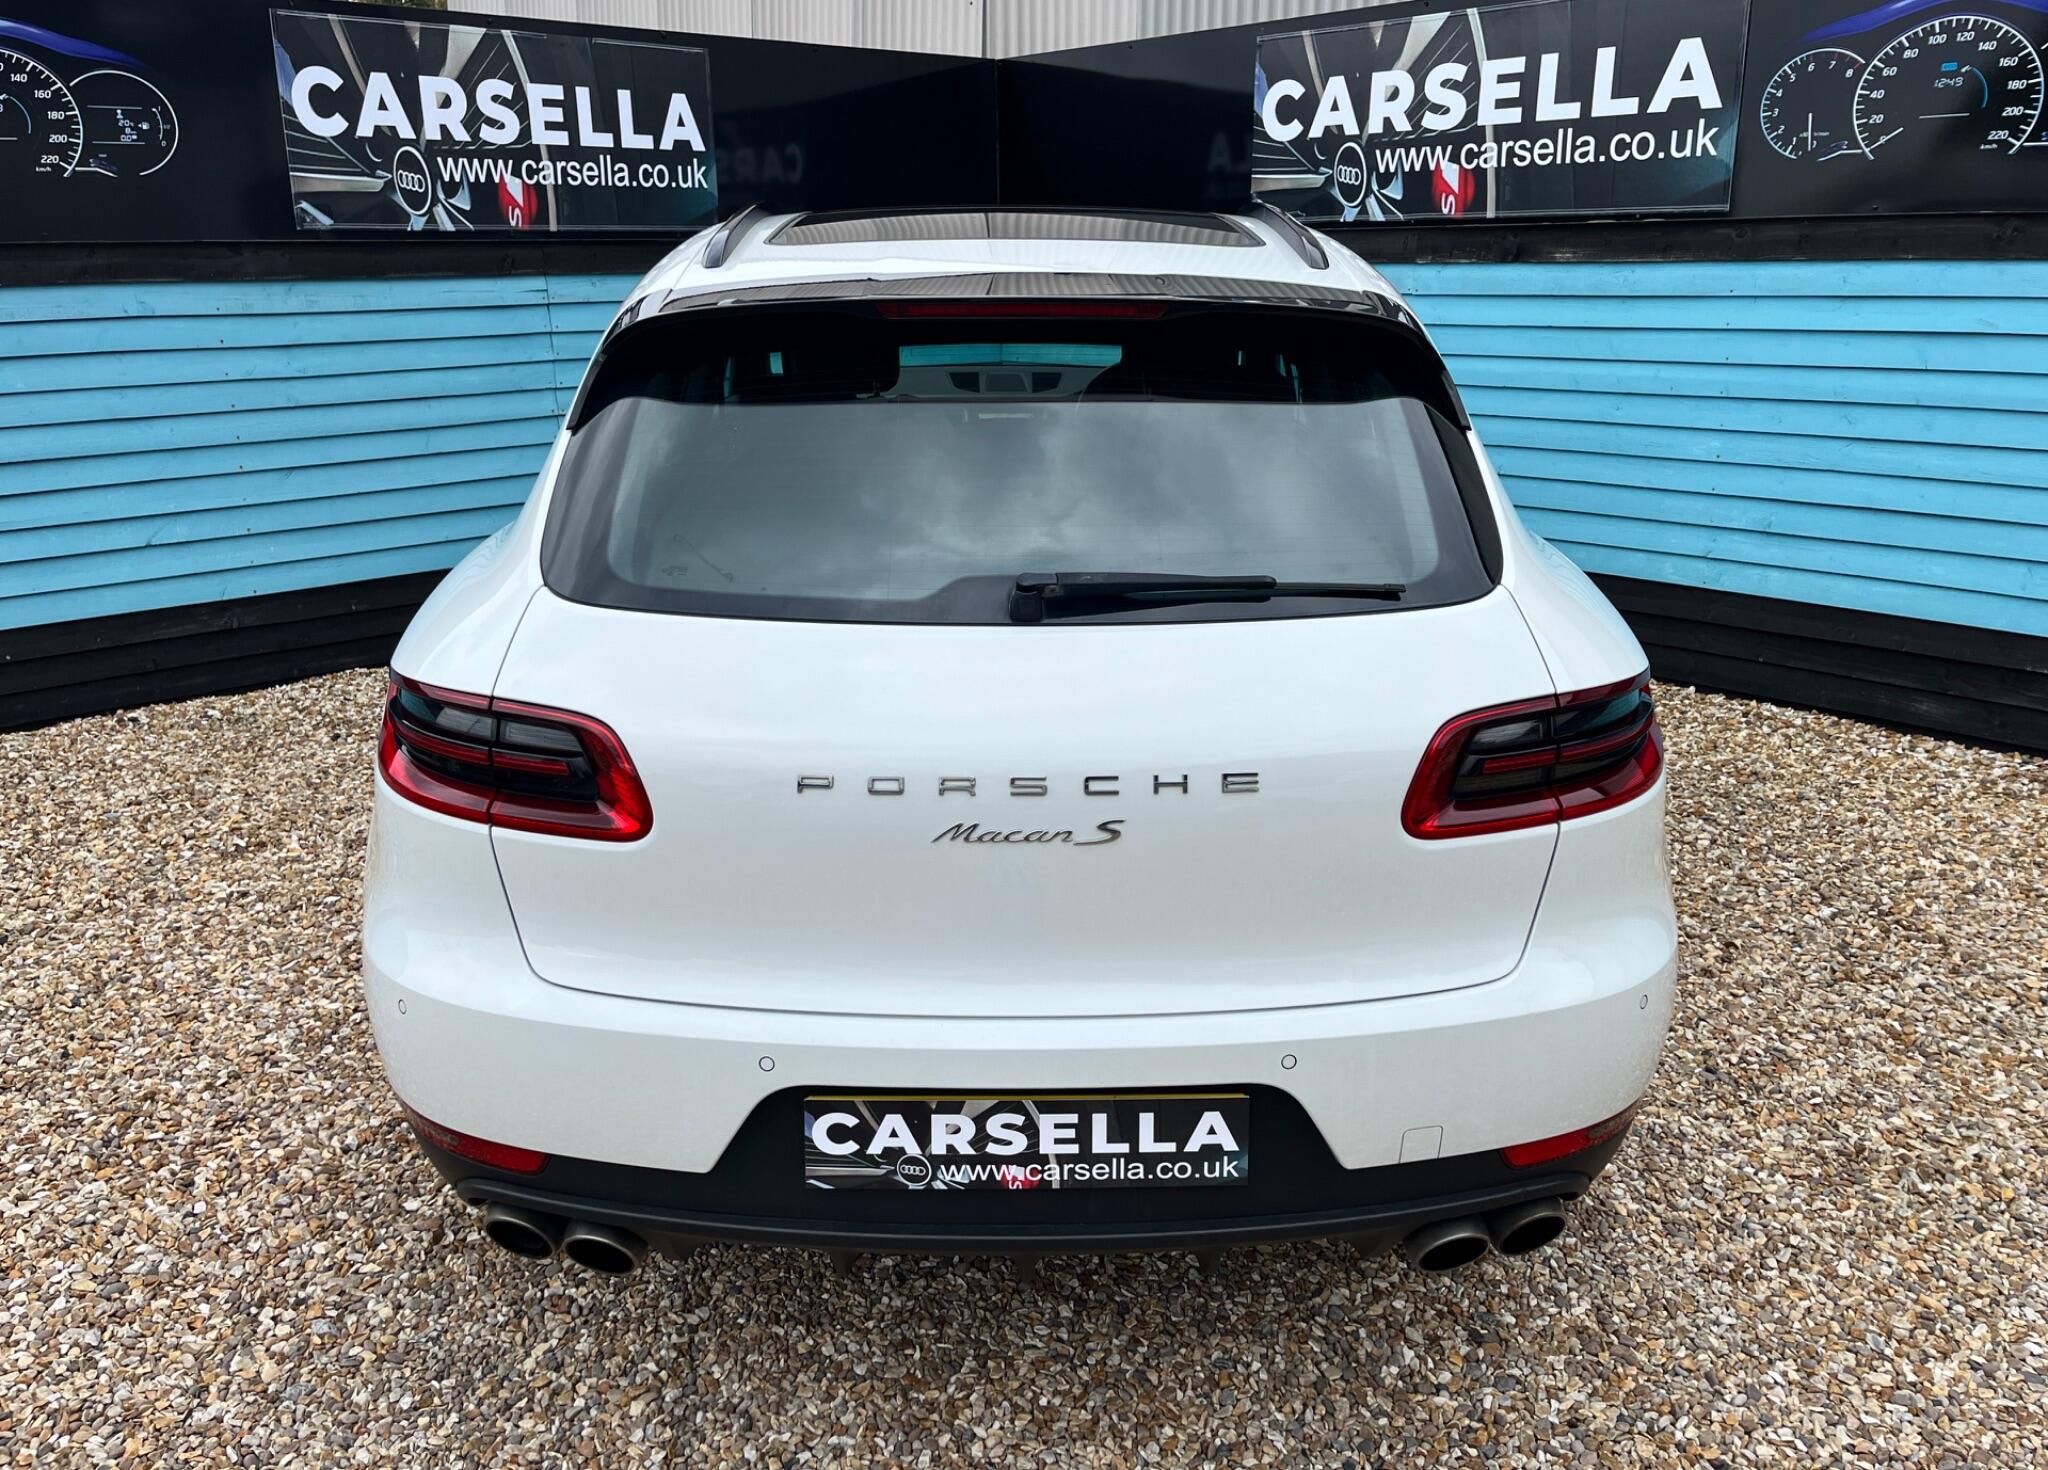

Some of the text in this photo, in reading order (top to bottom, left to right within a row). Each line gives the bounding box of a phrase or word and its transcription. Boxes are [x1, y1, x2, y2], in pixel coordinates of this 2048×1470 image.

[1928, 34, 1947, 45] 100
[1956, 31, 1975, 42] 120
[1978, 41, 1997, 51] 140
[1903, 49, 1919, 59] 80
[1829, 61, 1836, 70] 7
[1999, 57, 2018, 67] 160
[1808, 63, 1816, 72] 6
[1882, 67, 1897, 76] 60
[10, 73, 28, 82] 140
[1790, 73, 1797, 82] 5
[1845, 68, 1854, 78] 8
[1262, 36, 1722, 142] CARSELLA
[2007, 80, 2027, 90] 180
[34, 90, 51, 98] 160
[1776, 88, 1783, 97] 4
[1870, 89, 1885, 99] 40
[290, 65, 706, 152] CARSELLA
[1772, 108, 1779, 117] 3
[2001, 106, 2024, 116] 200
[47, 111, 65, 120] 180
[1869, 114, 1884, 123] 20
[1778, 126, 1785, 134] 2
[1987, 130, 2009, 140] 220
[49, 134, 67, 143] 200
[41, 155, 59, 163] 220
[797, 772, 1259, 797] PORSCHE
[931, 818, 1126, 846] Macan S
[811, 1111, 1239, 1155] CARSELLA
